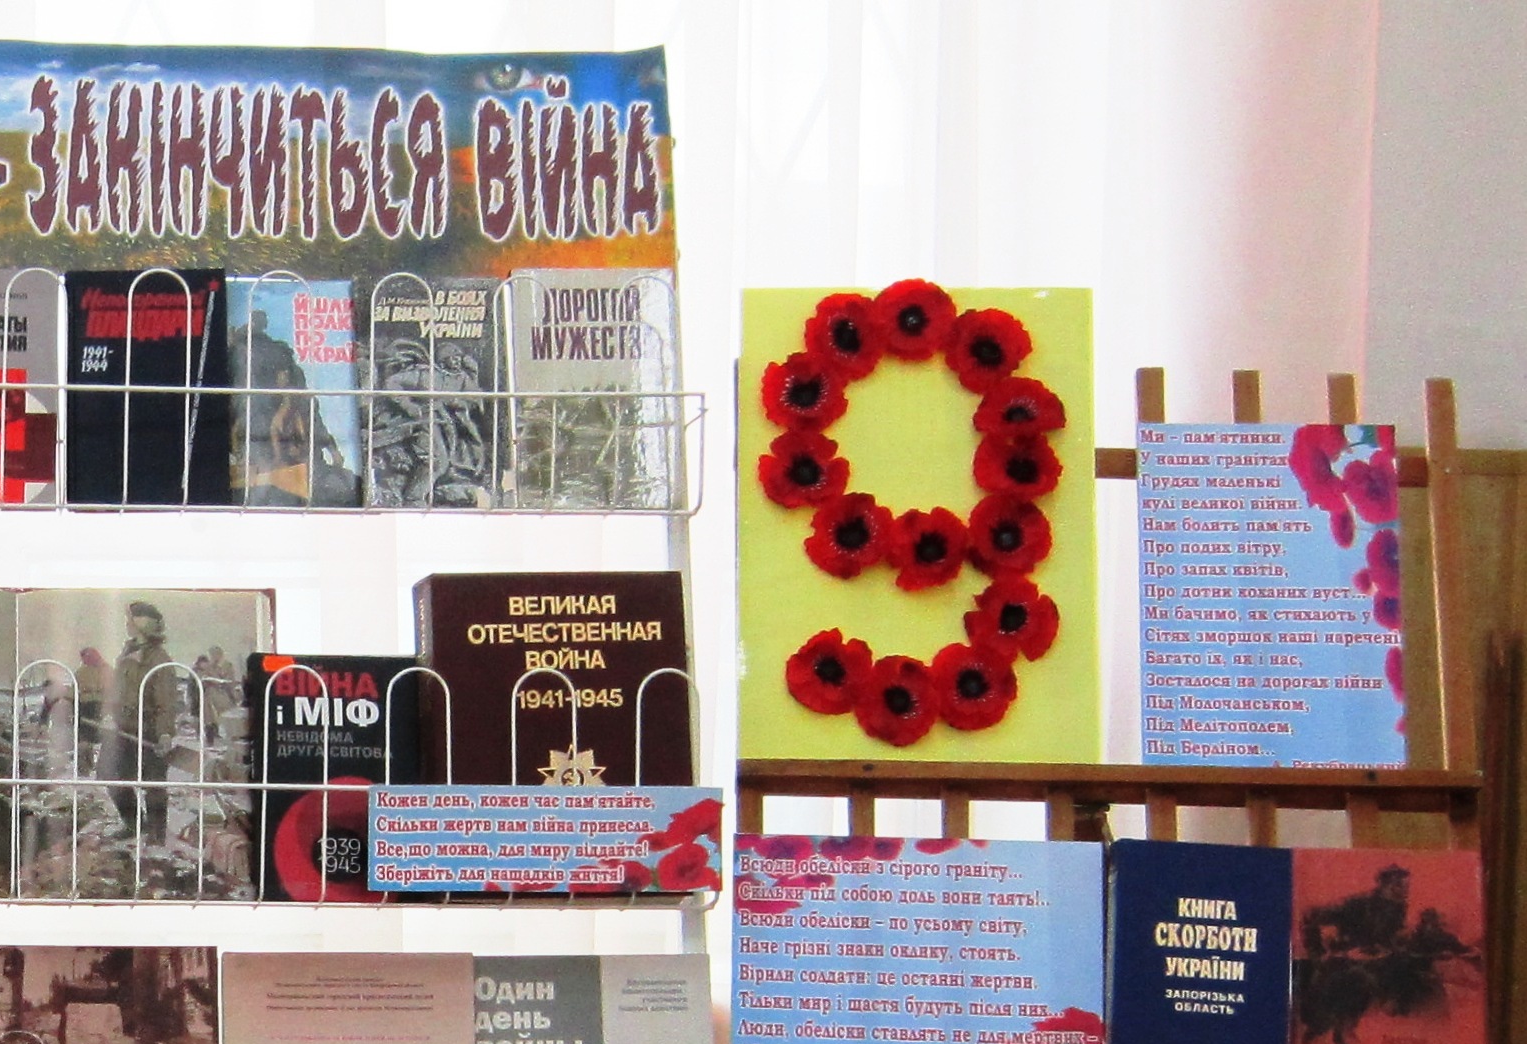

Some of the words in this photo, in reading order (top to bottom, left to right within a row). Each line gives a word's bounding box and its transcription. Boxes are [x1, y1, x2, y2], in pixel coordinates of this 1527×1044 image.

[29, 73, 447, 240] ЗАКІНЧИТЬСЯ
[475, 75, 660, 241] ВІЙНА
[435, 292, 447, 306] В
[450, 291, 486, 307] БОЯХ
[1143, 517, 1176, 531] Нам
[1182, 518, 1240, 532] болить
[509, 595, 616, 615] ВЕЛИКАЯ
[467, 622, 662, 644] ОТЕЧЕСТВЕННАЯ
[525, 648, 606, 670] ВОЙНА
[517, 689, 623, 708] 1941-1945
[277, 705, 283, 724] і
[295, 697, 379, 727] МІФ
[277, 744, 324, 758] ДРУГА
[376, 794, 428, 808] Кожен
[433, 795, 475, 810] день,
[481, 796, 528, 808] кожен
[534, 796, 559, 808] час
[376, 817, 438, 833] Скільки
[443, 820, 491, 834] жертв
[497, 821, 527, 833] нам
[533, 818, 573, 833] війна
[579, 820, 654, 835] принесла.
[1178, 897, 1238, 921] КНИГА
[739, 911, 794, 930] Всюди
[799, 912, 871, 929] обеліски
[739, 938, 778, 955] Наче
[784, 941, 831, 959] грізні
[837, 943, 884, 958] знаки
[1154, 924, 1258, 954] СКОРБОТИ
[1165, 955, 1245, 981] УКРАЇНИ
[475, 977, 555, 1004] Один
[1165, 989, 1245, 1004] ЗАПОРІЗЬКА
[1174, 1002, 1235, 1016] ОБЛАСТЬ
[474, 1010, 551, 1033] день
